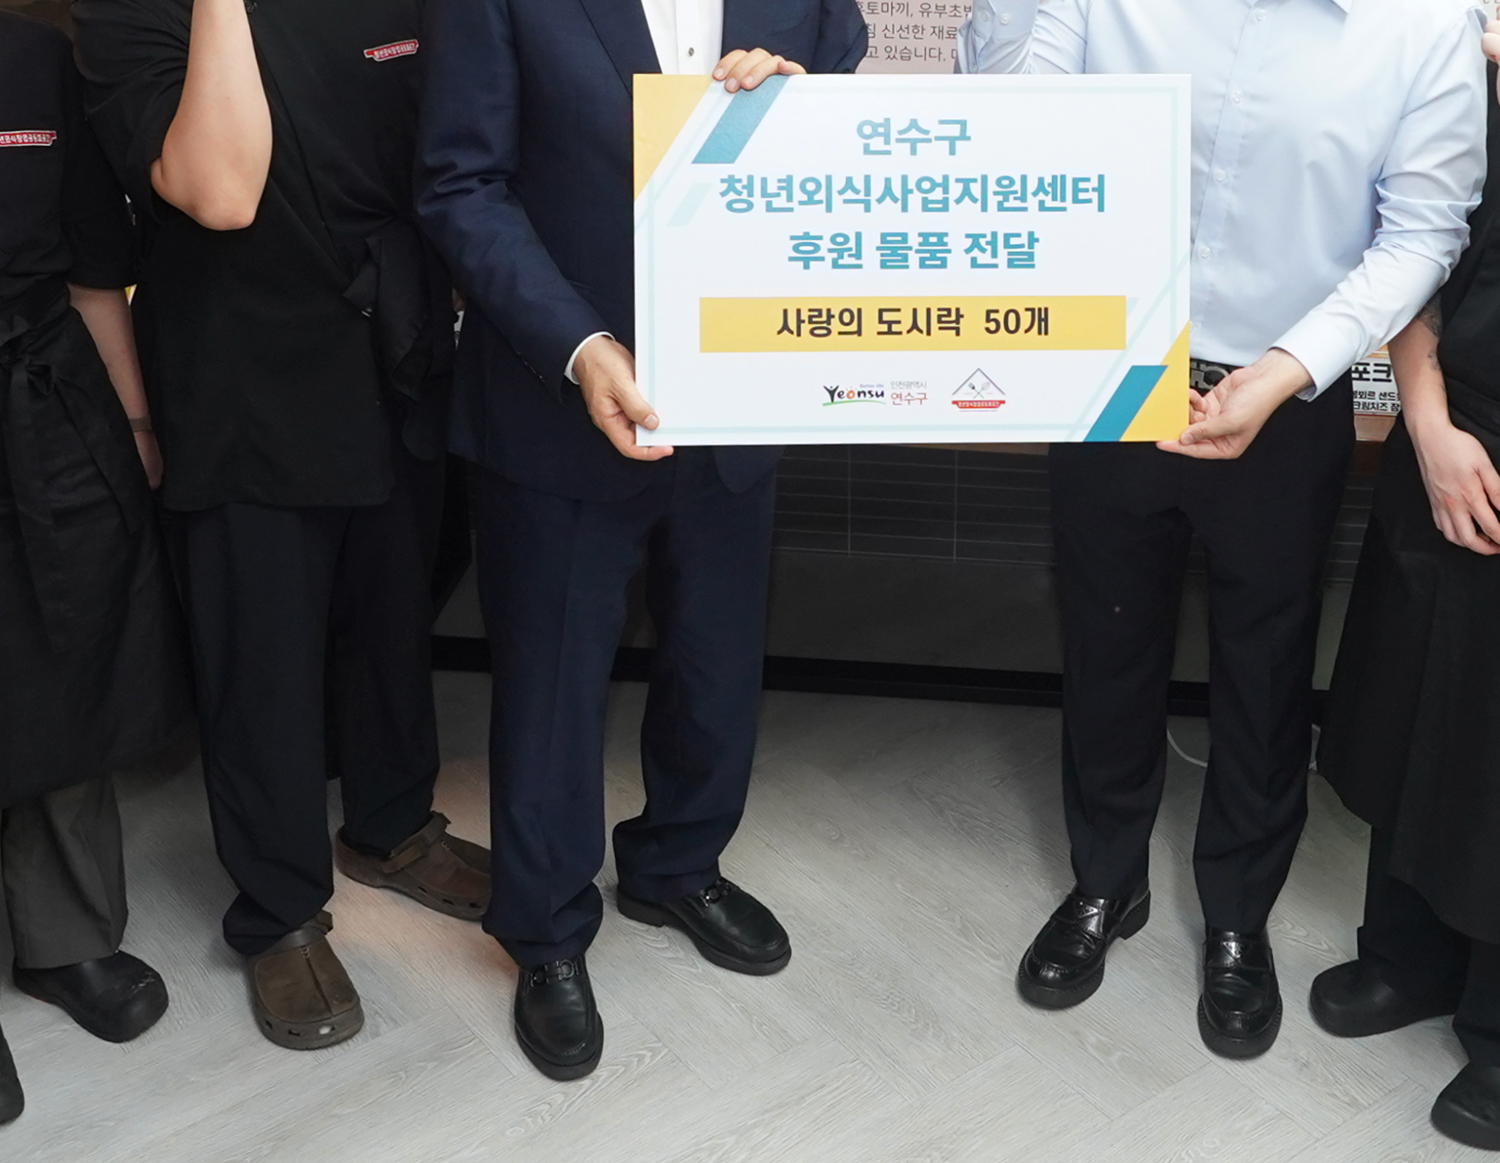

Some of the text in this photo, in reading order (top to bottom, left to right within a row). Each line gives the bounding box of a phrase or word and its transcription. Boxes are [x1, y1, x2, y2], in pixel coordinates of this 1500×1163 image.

[882, 25, 925, 39] 신선한
[885, 45, 946, 61] 있습니다.
[856, 118, 972, 156] 연수구
[718, 174, 1106, 214] 청년외식사업지원센터
[788, 231, 1040, 270] 후원 물품 전달
[777, 307, 1050, 338] 사랑의 도시락 50개
[823, 385, 928, 406] Yeonsu 연수구
